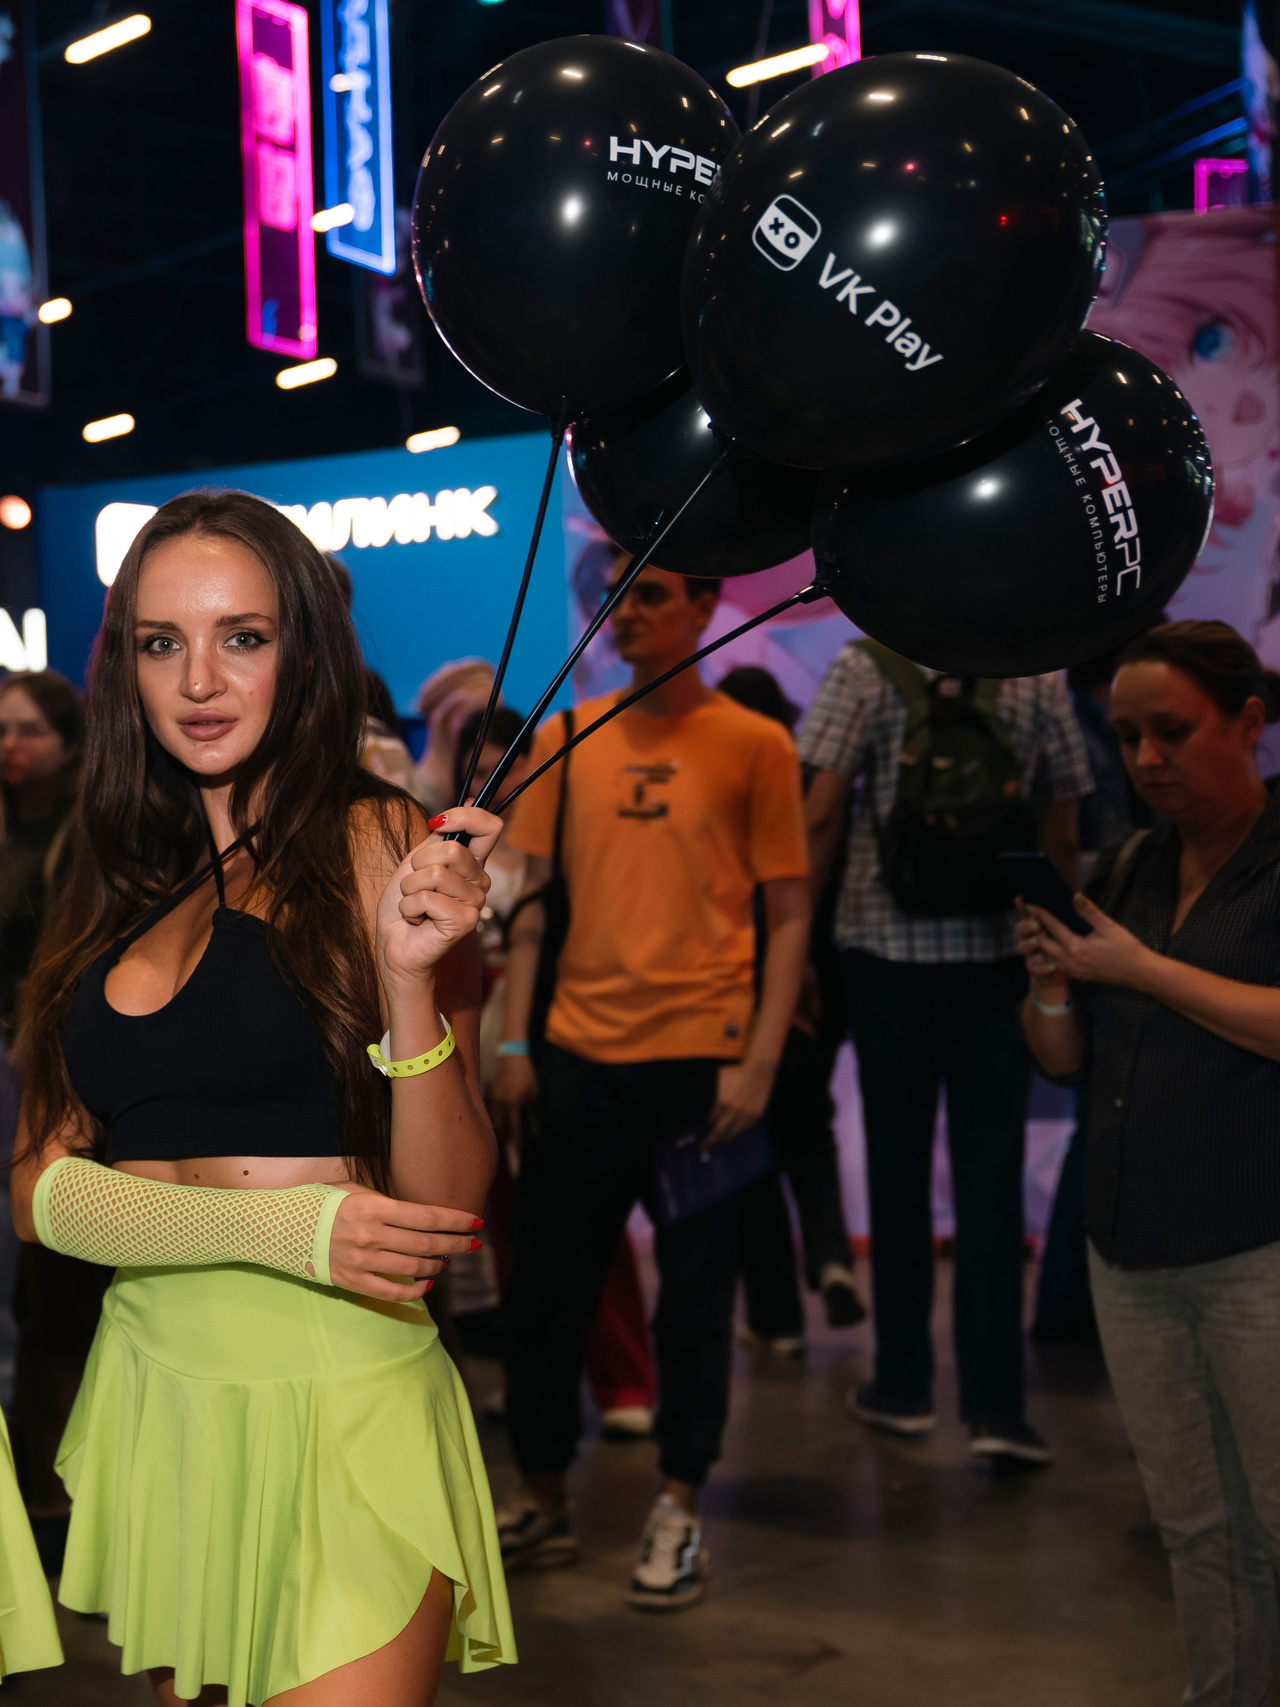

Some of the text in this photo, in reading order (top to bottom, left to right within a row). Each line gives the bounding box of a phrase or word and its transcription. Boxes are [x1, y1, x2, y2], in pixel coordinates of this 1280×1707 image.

[607, 171, 683, 196] МОЩНЫЕ
[818, 252, 944, 371] VK Play
[1046, 419, 1108, 604] ОЩНЫЕ КОМПЬЮТЕРЫ
[1060, 398, 1141, 596] HYPERPC
